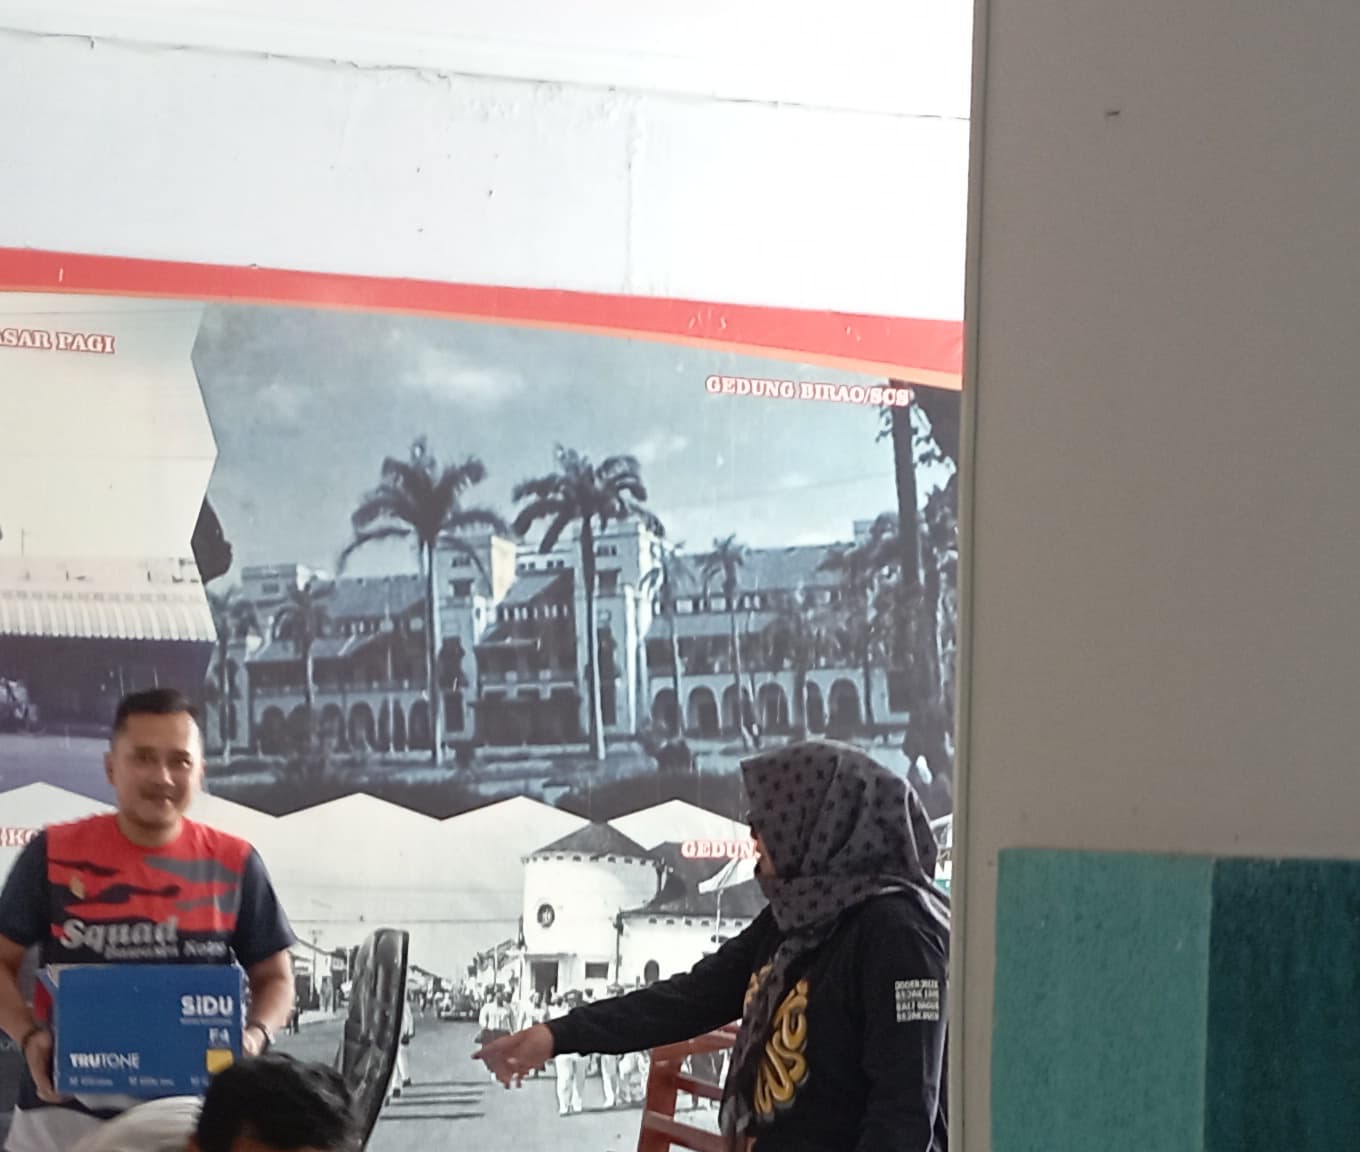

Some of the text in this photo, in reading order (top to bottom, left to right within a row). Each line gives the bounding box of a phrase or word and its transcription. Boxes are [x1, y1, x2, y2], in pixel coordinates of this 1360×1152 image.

[55, 332, 116, 354] PAGI
[705, 375, 912, 407] GEDUNG BIRAO/SCS
[6, 826, 34, 847] KO
[681, 839, 760, 860] GEDUN
[60, 915, 180, 953] Squad
[69, 1052, 140, 1070] TRUTONE
